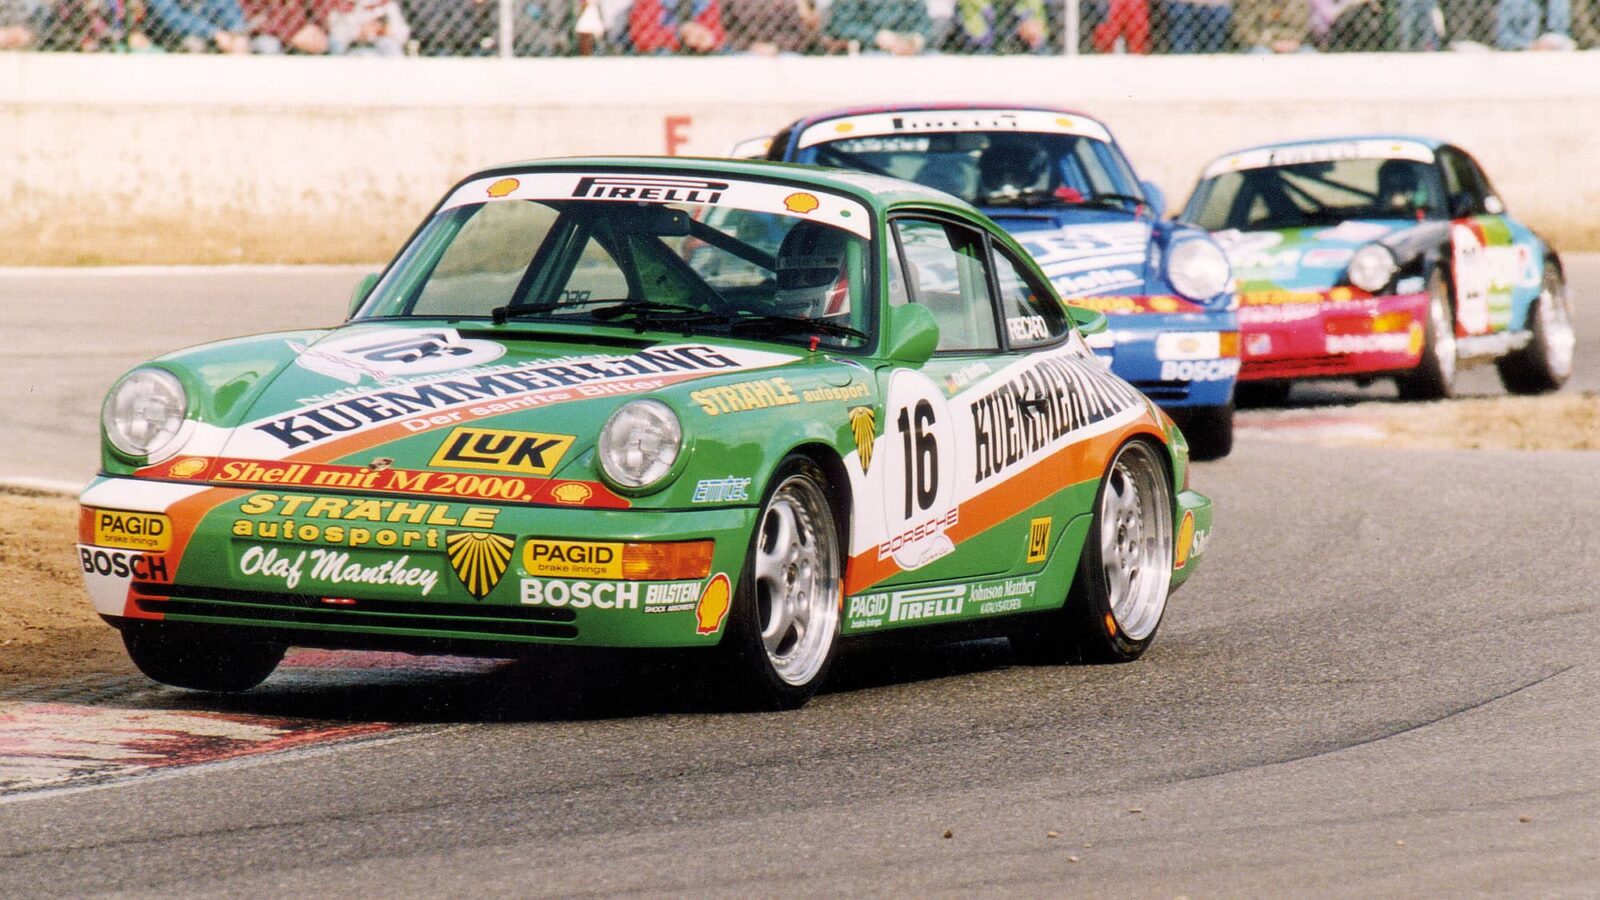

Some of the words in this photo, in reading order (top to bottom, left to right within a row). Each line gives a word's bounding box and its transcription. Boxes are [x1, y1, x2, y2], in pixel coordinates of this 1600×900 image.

[571, 177, 729, 204] PIRELLI
[1006, 315, 1049, 340] RECARO
[1160, 358, 1242, 382] BOSCH
[253, 346, 741, 449] KUEMMERLING
[401, 410, 461, 433] Der
[469, 390, 571, 416] sanfte
[576, 379, 664, 398] Bitter
[802, 383, 870, 404] autosport
[897, 398, 939, 521] 16
[215, 461, 307, 485] Shell
[312, 468, 381, 489] mit
[100, 513, 164, 537] PAGID
[241, 493, 502, 530] STRÄHLE
[104, 534, 127, 543] brake
[130, 535, 159, 548] linings
[231, 519, 439, 548] autosport
[880, 507, 957, 554] PORSCHE
[79, 548, 169, 582] BOSCH
[531, 544, 614, 565] PAGID
[240, 546, 304, 590] Olaf
[306, 549, 439, 597] Manthey
[537, 563, 569, 574] brake
[571, 563, 607, 575] linings
[519, 578, 639, 610] BOSCH
[645, 582, 702, 604] BILSTEIN
[848, 592, 890, 619] PAGID
[888, 583, 967, 622] PIRELLI
[968, 584, 1004, 603] Johnson
